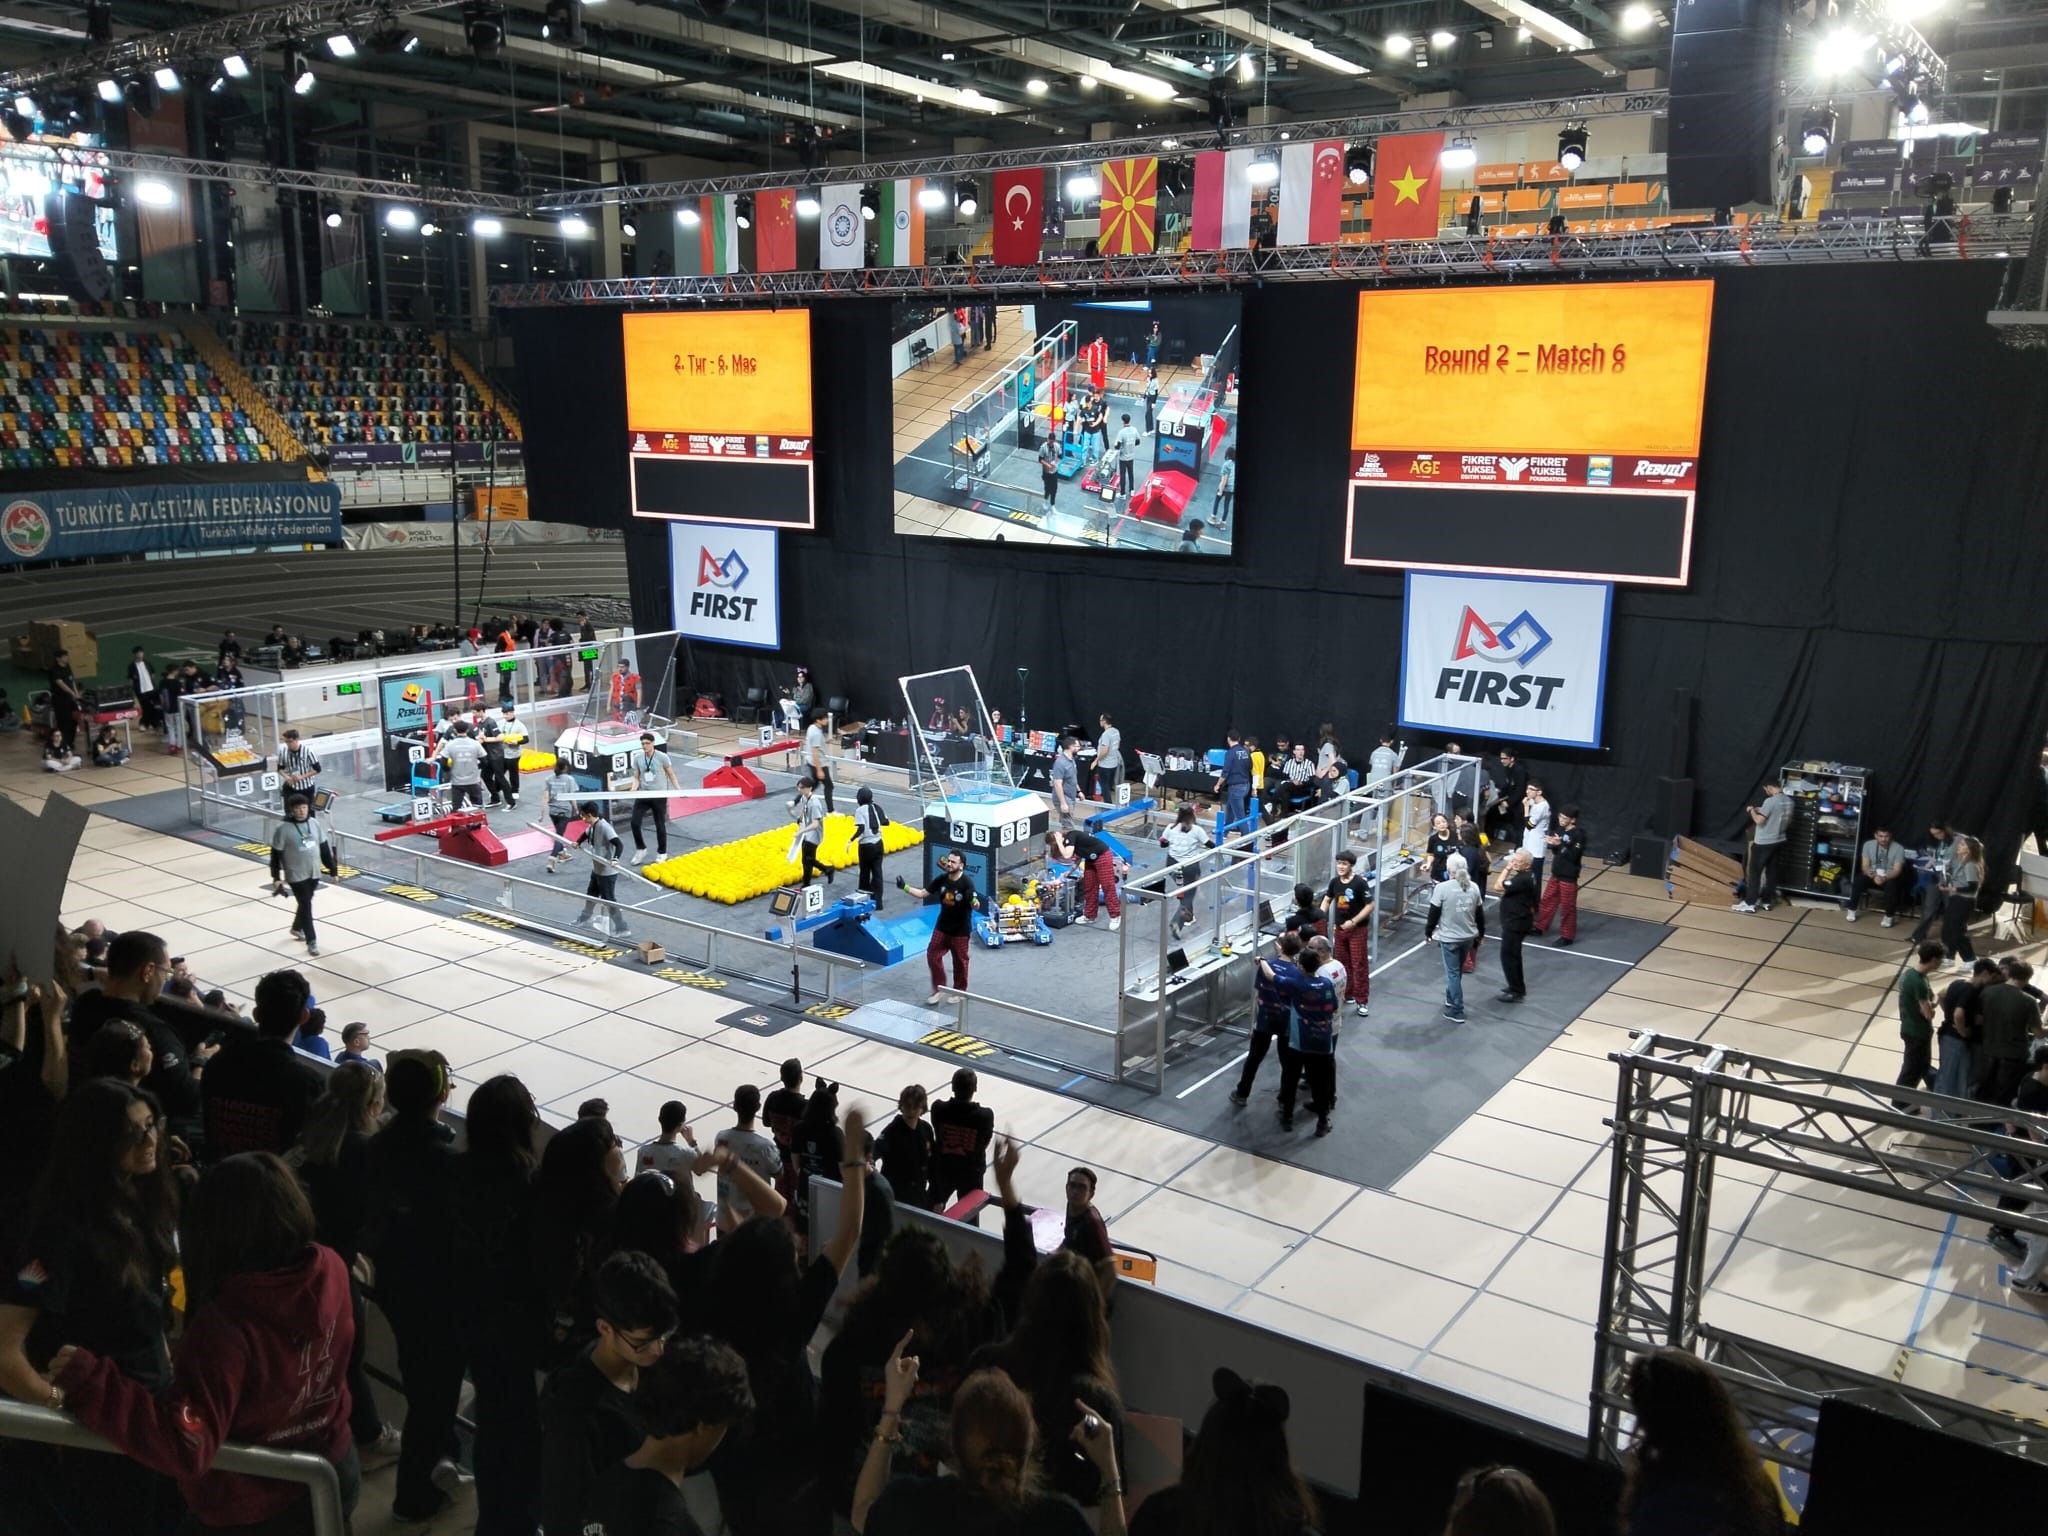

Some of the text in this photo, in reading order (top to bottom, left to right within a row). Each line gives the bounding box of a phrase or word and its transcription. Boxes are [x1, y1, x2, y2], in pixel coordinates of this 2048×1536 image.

[1424, 343, 1490, 364] Round
[1497, 344, 1509, 365] 2
[1537, 342, 1605, 364] Match
[1613, 343, 1626, 363] 6
[673, 354, 685, 370] 2.
[687, 354, 707, 369] Tur
[717, 354, 729, 370] 6.
[661, 437, 680, 450] AGE
[1409, 460, 1441, 475] AGE
[1461, 465, 1497, 474] YUKSEL
[1530, 466, 1568, 476] YUKSEL
[1632, 459, 1693, 477] REBUILT
[55, 494, 333, 528] TÜRKİYE ATLETİZM FEDERASYONU
[200, 525, 237, 539] Turkish
[277, 522, 333, 536] Federation
[408, 529, 432, 537] WORLD
[689, 591, 759, 622] FIRST
[1434, 667, 1566, 711] FIRST
